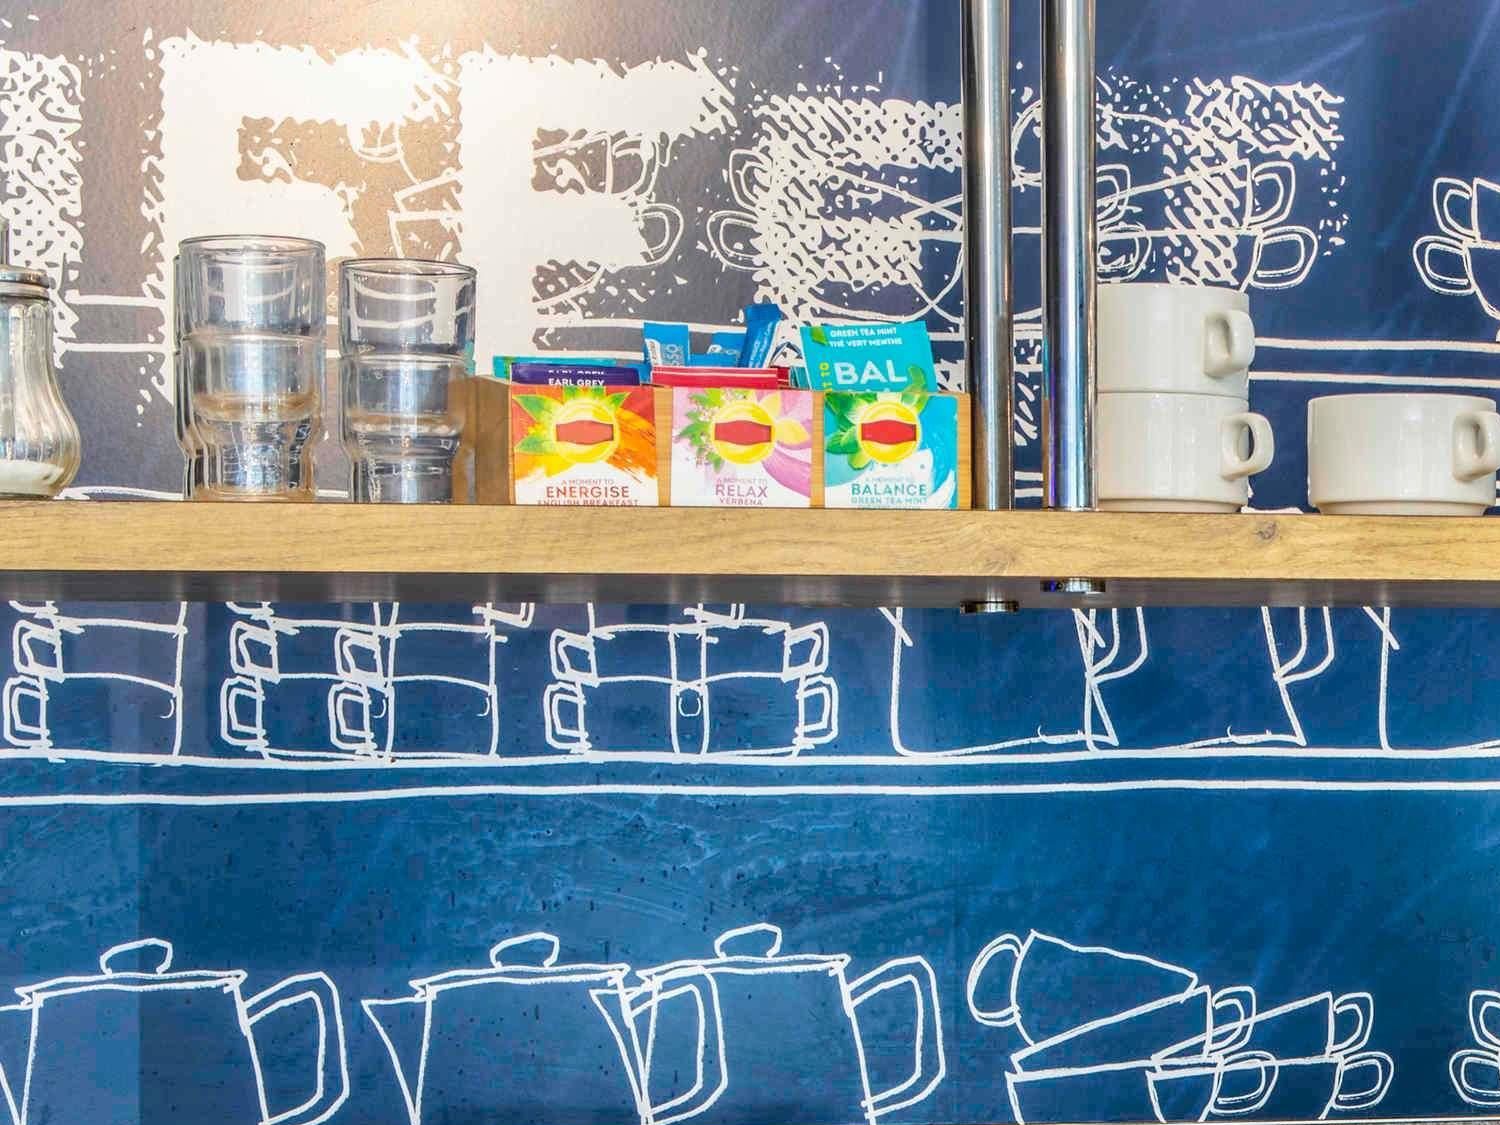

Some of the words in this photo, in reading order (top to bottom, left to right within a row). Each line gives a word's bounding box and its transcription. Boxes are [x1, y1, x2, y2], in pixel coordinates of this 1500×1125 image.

[830, 328, 859, 338] GREEN
[860, 328, 876, 337] TEA
[877, 327, 897, 336] MINT
[846, 338, 867, 347] VERT
[868, 337, 903, 347] MENTHE
[834, 359, 908, 385] BAL
[548, 378, 573, 386] EARL
[576, 378, 605, 386] GREY
[546, 486, 630, 499] ENERGISE
[714, 484, 768, 499] RELAX
[851, 483, 927, 496] BALANCE
[719, 497, 763, 506] VERBENA
